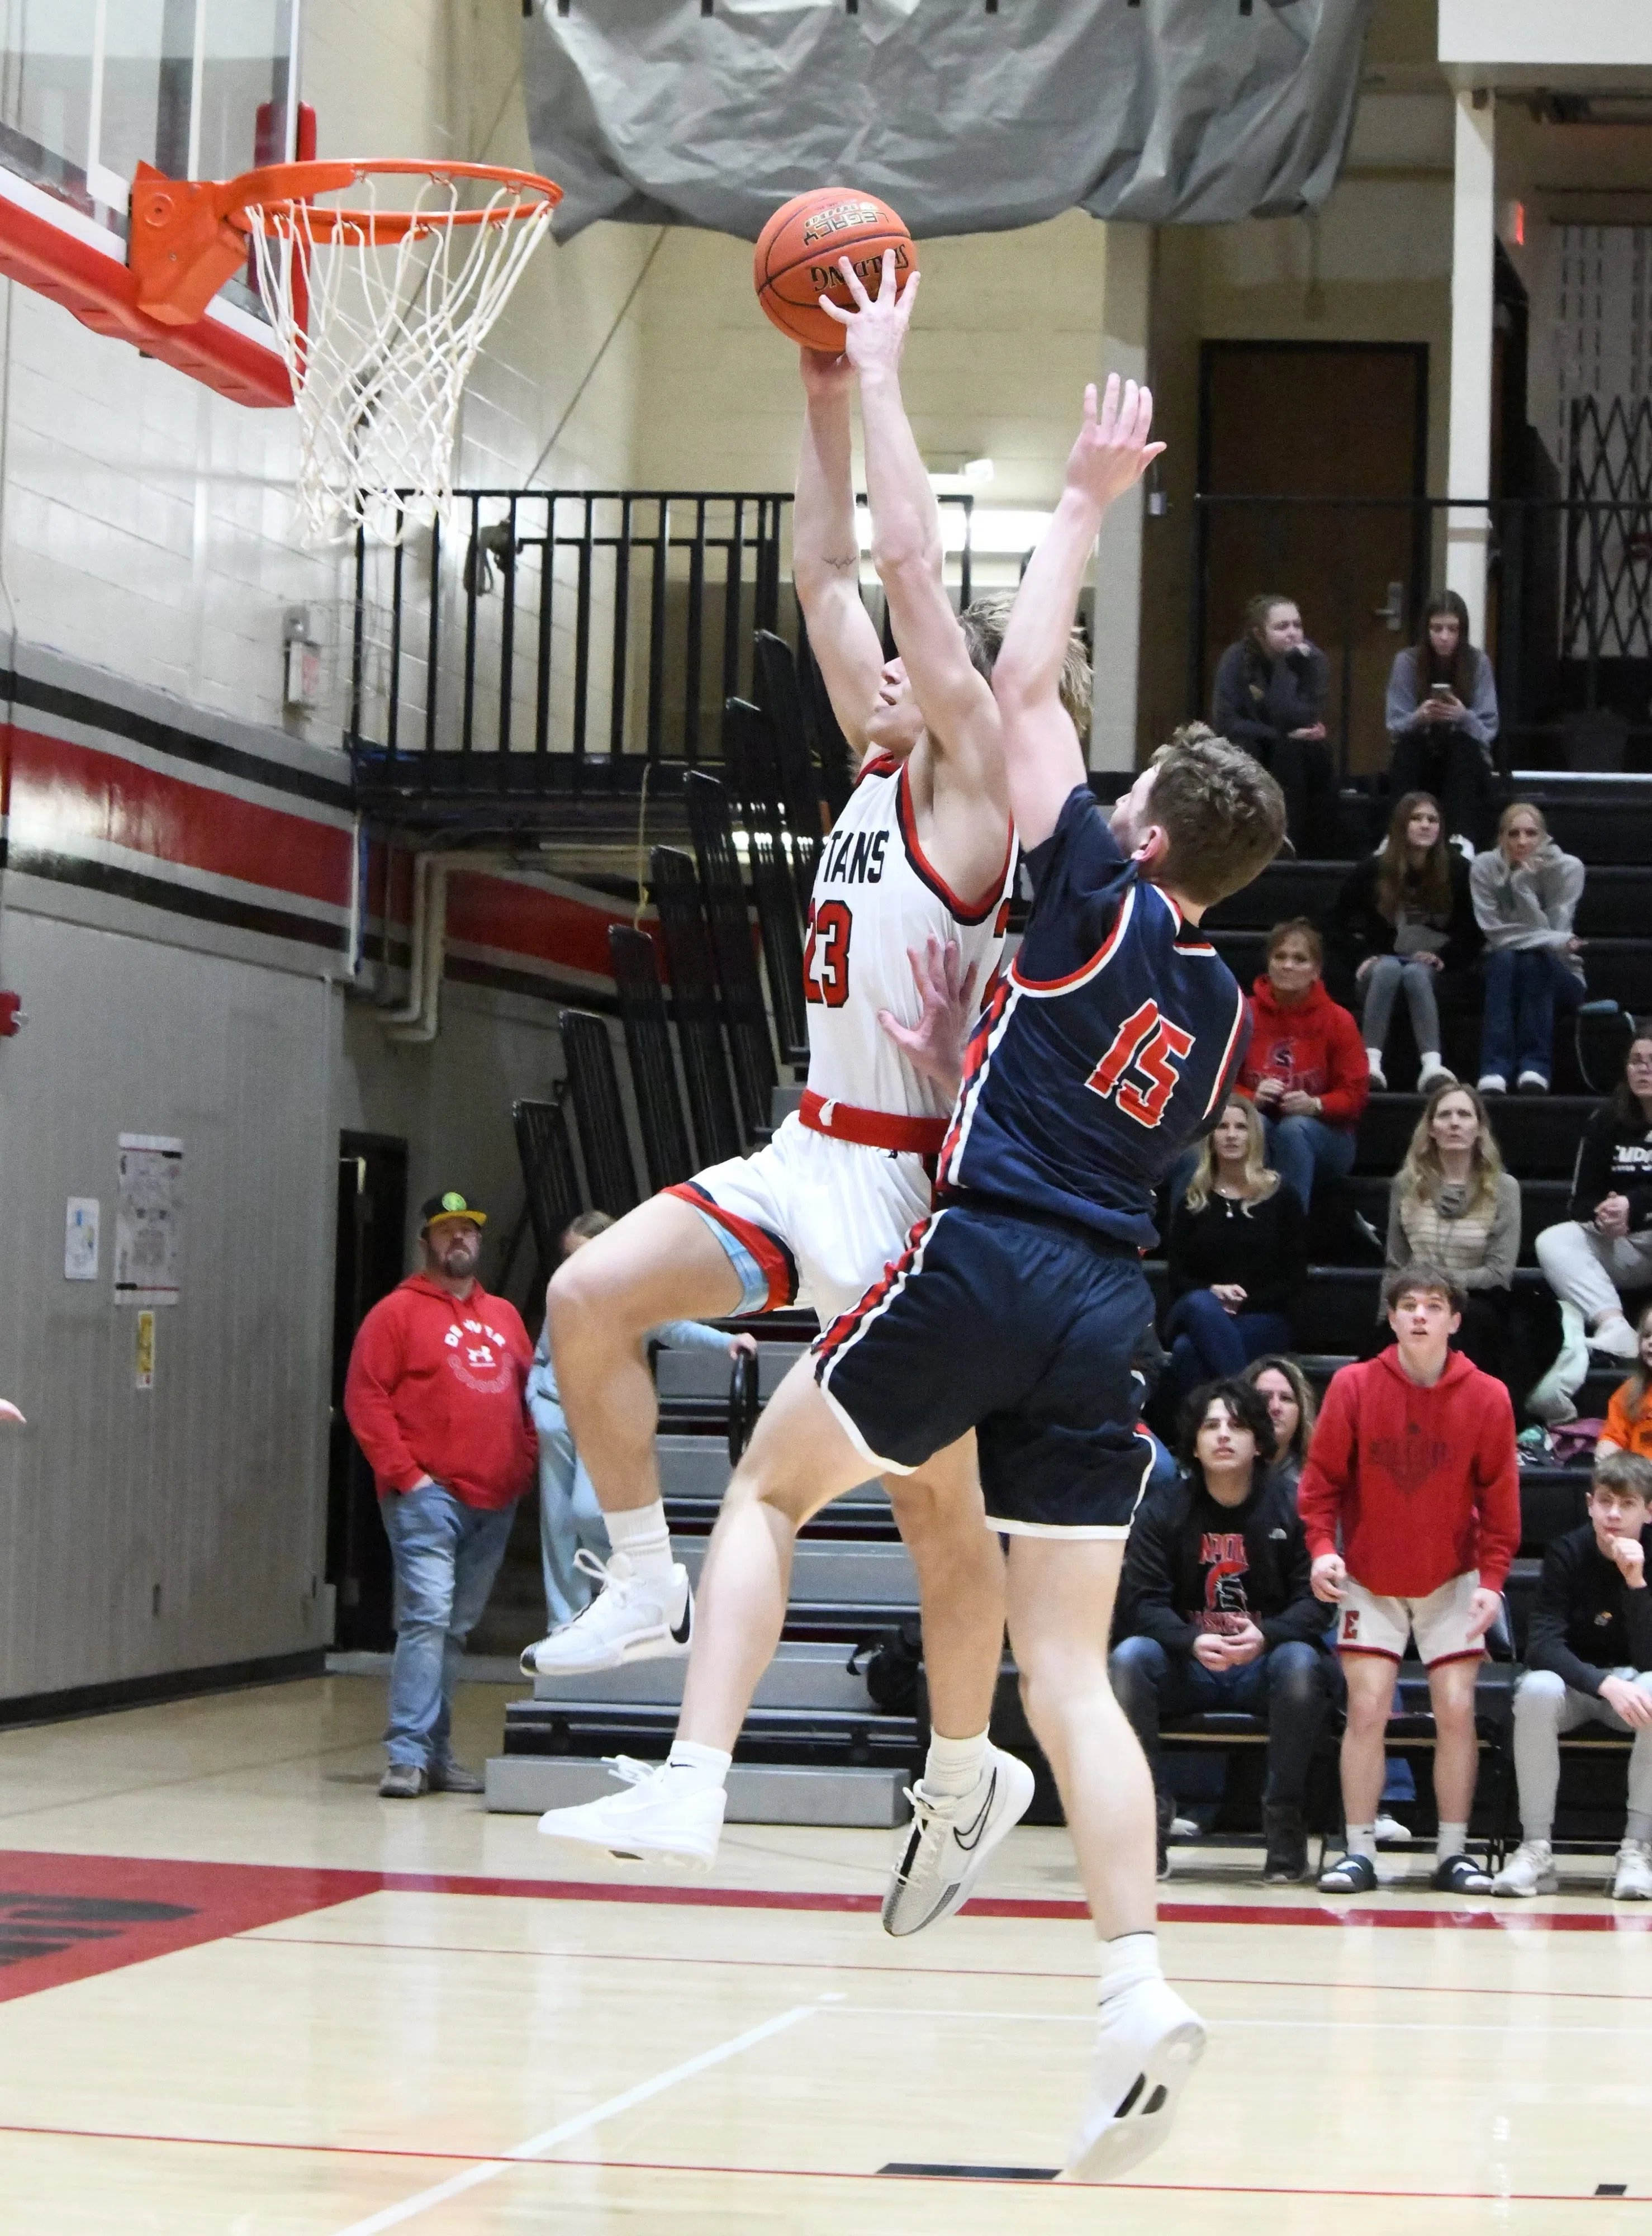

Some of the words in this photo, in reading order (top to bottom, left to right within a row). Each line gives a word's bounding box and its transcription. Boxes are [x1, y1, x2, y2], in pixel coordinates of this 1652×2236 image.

[803, 210, 890, 246] LEGACY
[810, 244, 910, 292] SLDNG
[822, 830, 890, 884] TANS
[803, 898, 853, 1008] 23
[1084, 998, 1196, 1129] 15
[1343, 1610, 1360, 1639] E
